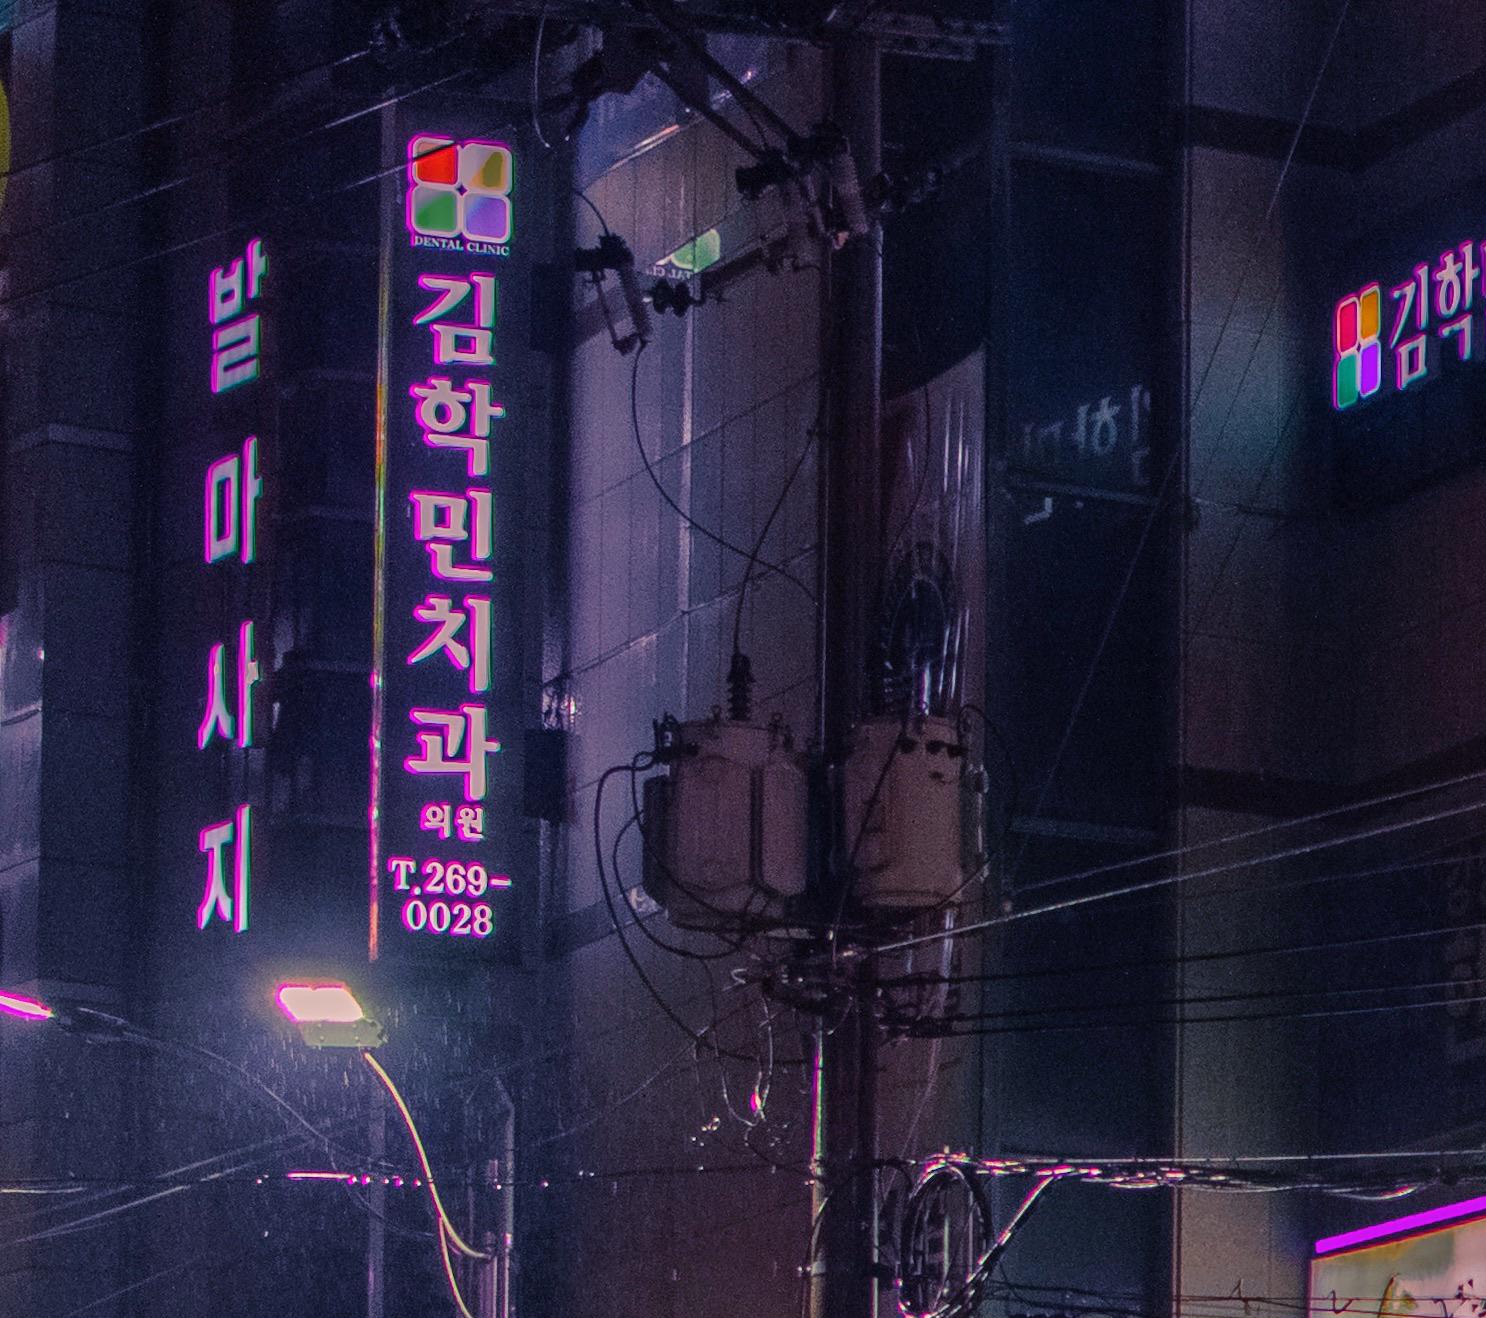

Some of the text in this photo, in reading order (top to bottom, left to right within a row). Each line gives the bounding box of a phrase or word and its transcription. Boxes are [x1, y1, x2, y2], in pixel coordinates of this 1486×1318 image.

[413, 235, 509, 256] DENTAL CLINIC
[408, 273, 505, 800] 김학민치과
[199, 238, 268, 933] 발마사지
[420, 805, 486, 840] 의원
[404, 899, 494, 937] 0028
